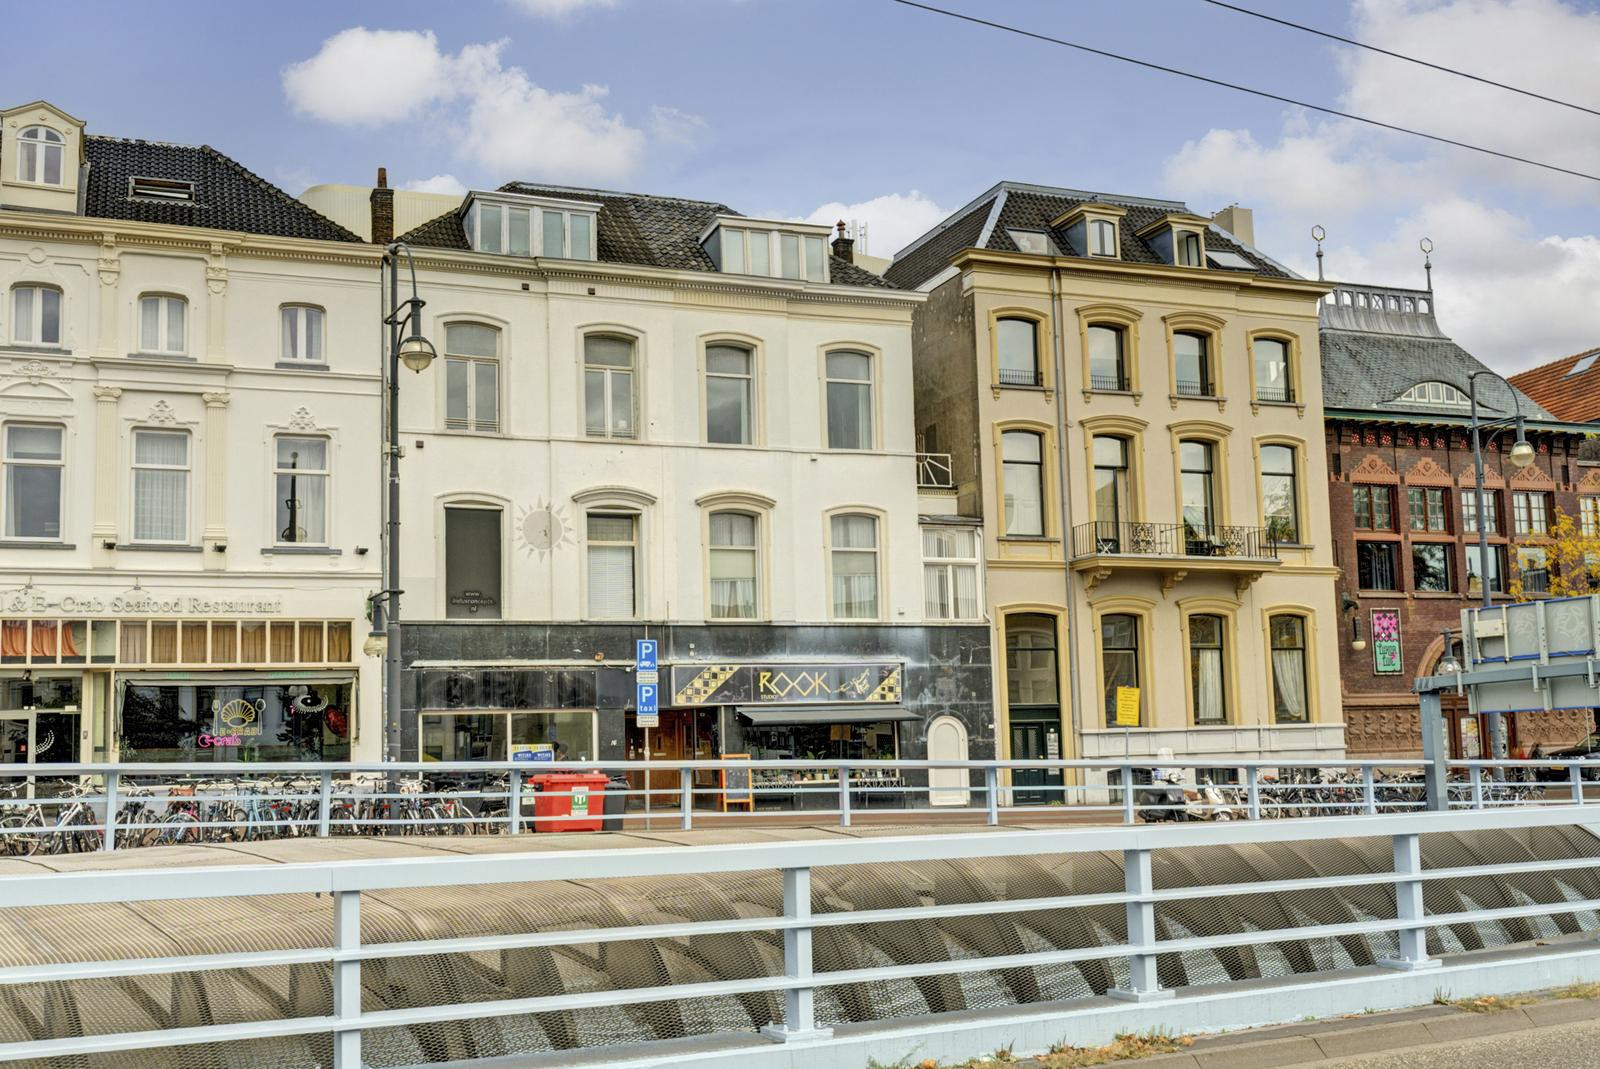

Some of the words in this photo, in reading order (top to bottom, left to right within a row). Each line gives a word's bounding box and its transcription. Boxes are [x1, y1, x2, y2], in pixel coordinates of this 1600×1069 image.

[110, 596, 183, 613] Seafood
[188, 597, 283, 613] Restaurant
[641, 642, 653, 659] P
[759, 671, 831, 697] ROOK
[641, 686, 653, 703] P
